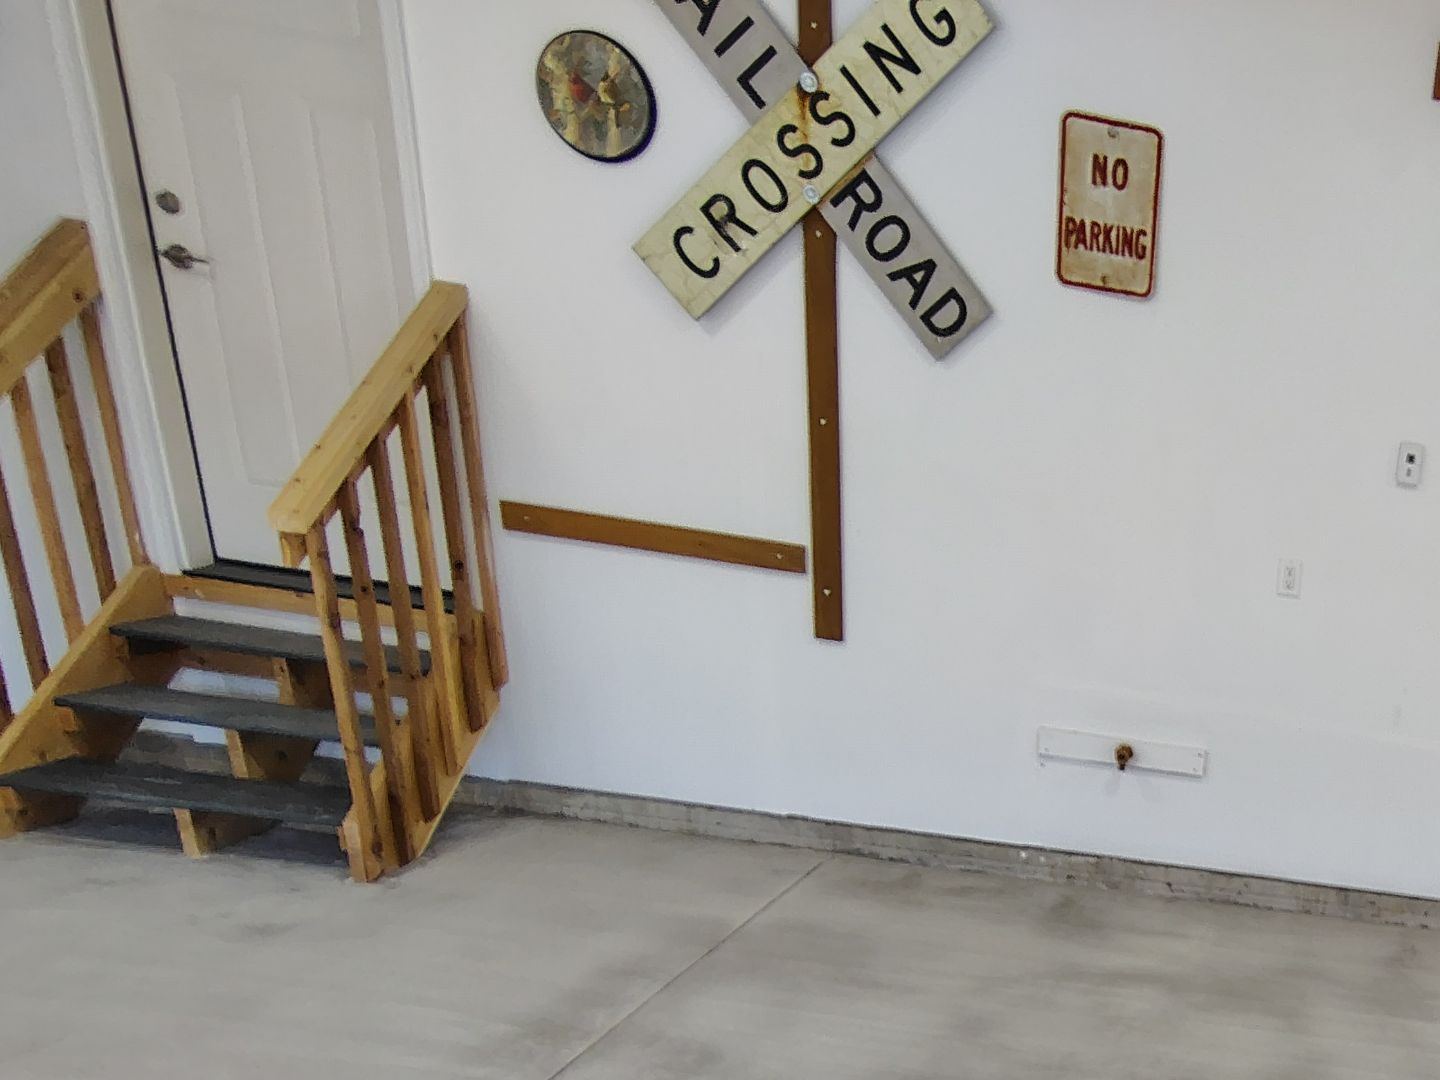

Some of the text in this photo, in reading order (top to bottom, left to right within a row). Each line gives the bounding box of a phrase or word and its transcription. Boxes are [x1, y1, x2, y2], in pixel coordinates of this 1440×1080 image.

[674, 0, 778, 110] AIL
[672, 0, 957, 280] CROSSING
[1091, 153, 1129, 191] NO
[829, 167, 968, 339] ROAD
[1063, 215, 1148, 261] PARKING
